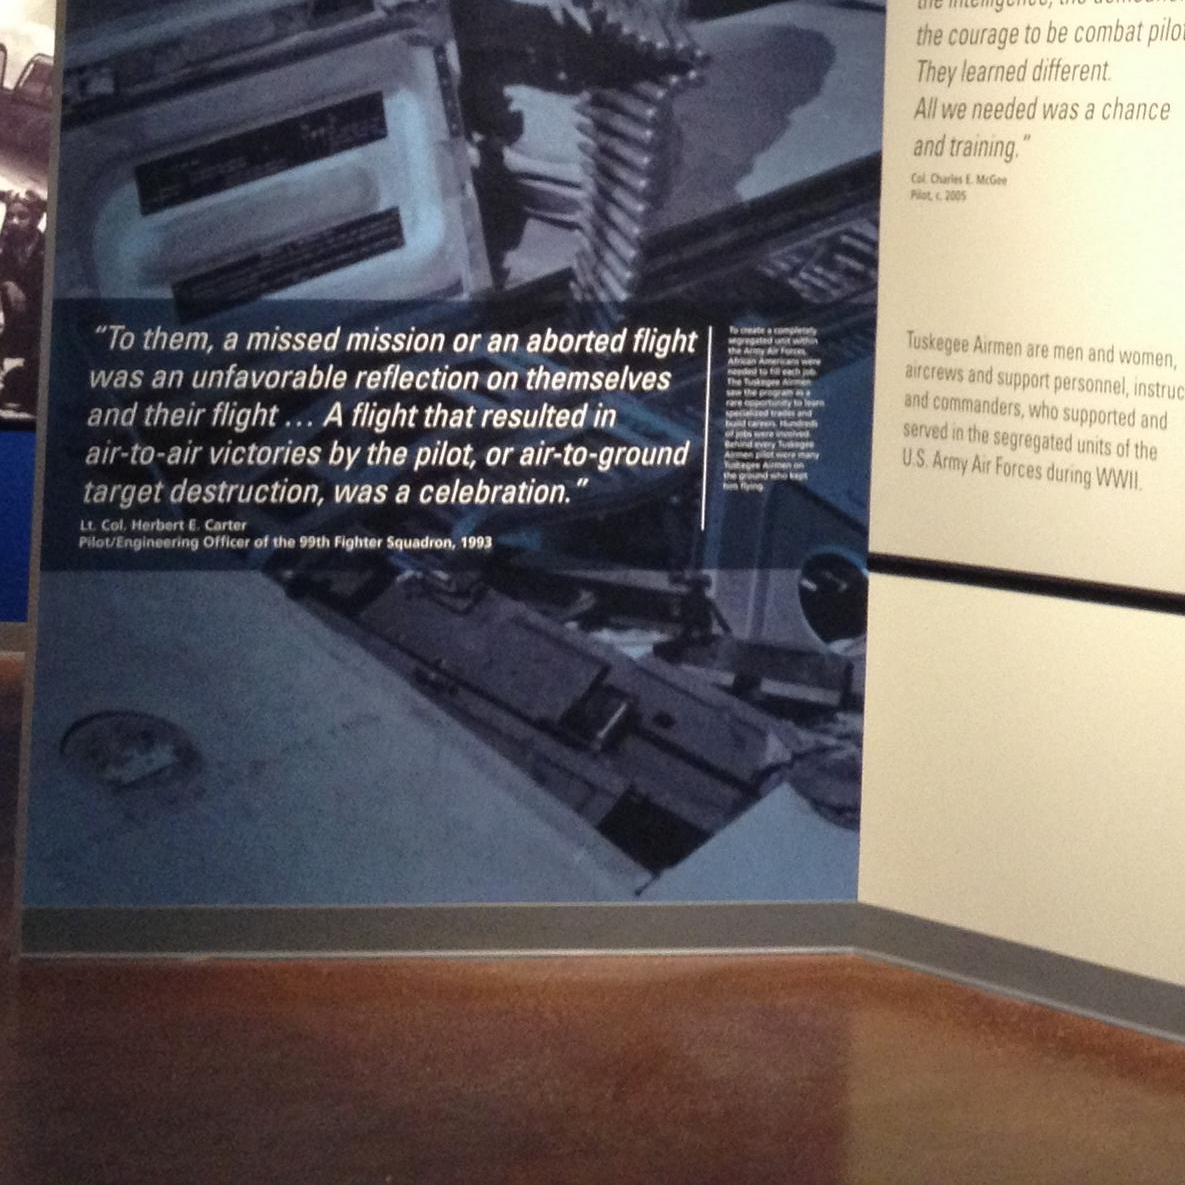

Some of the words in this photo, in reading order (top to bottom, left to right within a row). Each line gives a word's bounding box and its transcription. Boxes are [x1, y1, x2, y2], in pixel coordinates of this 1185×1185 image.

[916, 23, 943, 45] the
[948, 27, 1019, 50] courage
[1024, 24, 1041, 44] to
[1046, 20, 1068, 43] be
[1074, 18, 1143, 43] combat
[917, 59, 957, 87] They
[960, 58, 1028, 82] learned
[1031, 57, 1111, 81] different.
[913, 96, 937, 118] All
[941, 102, 967, 119] we
[971, 96, 1038, 119] needed
[1042, 102, 1079, 120] was
[1084, 102, 1095, 120] a
[1101, 96, 1170, 120] chance
[913, 133, 946, 156] and
[143, 326, 212, 353] them,
[223, 332, 238, 350] a
[246, 325, 340, 351] missed
[346, 326, 445, 352] mission
[452, 333, 481, 352] or
[486, 333, 518, 352] an
[526, 327, 627, 352] aborted
[632, 327, 698, 358] flight
[906, 329, 968, 356] Tuskegee
[973, 334, 1021, 356] Airmen
[1026, 343, 1048, 358] are
[1053, 344, 1083, 360] men
[1088, 344, 1114, 363] and
[1119, 350, 1176, 370] women,
[91, 370, 143, 387] was
[151, 369, 183, 387] an
[192, 363, 347, 389] unfavorable
[354, 364, 479, 390] reflection
[486, 370, 518, 390] on
[526, 364, 671, 390] themselves
[905, 364, 963, 382] aircrews
[968, 365, 993, 384] and
[997, 371, 1049, 391] support
[1054, 375, 1128, 398] personnel,
[87, 402, 137, 425] and
[144, 402, 205, 425] their
[212, 401, 278, 432] flight
[322, 401, 342, 426] A
[351, 401, 417, 433] flight
[423, 402, 476, 428] that
[481, 402, 588, 428] resulted
[593, 402, 616, 427] in
[85, 440, 202, 464] air-to-air
[210, 440, 321, 465] victories
[328, 439, 361, 470] by
[366, 439, 407, 465] the
[413, 440, 476, 471] pilot,
[485, 446, 514, 466] or
[519, 440, 690, 471] air-to-ground
[84, 481, 163, 507] target
[170, 478, 323, 506] destruction,
[334, 484, 388, 503] was
[395, 484, 410, 503] a
[131, 518, 184, 530] Herbert
[204, 518, 246, 531] Carter
[79, 536, 198, 550] Pilot/Engineering
[203, 535, 249, 547] Officer
[254, 534, 268, 548] of
[273, 535, 295, 548] the
[299, 535, 329, 548] 99th
[334, 535, 382, 551] Fighter
[386, 535, 455, 551] Squadron,
[461, 535, 491, 548] 1993
